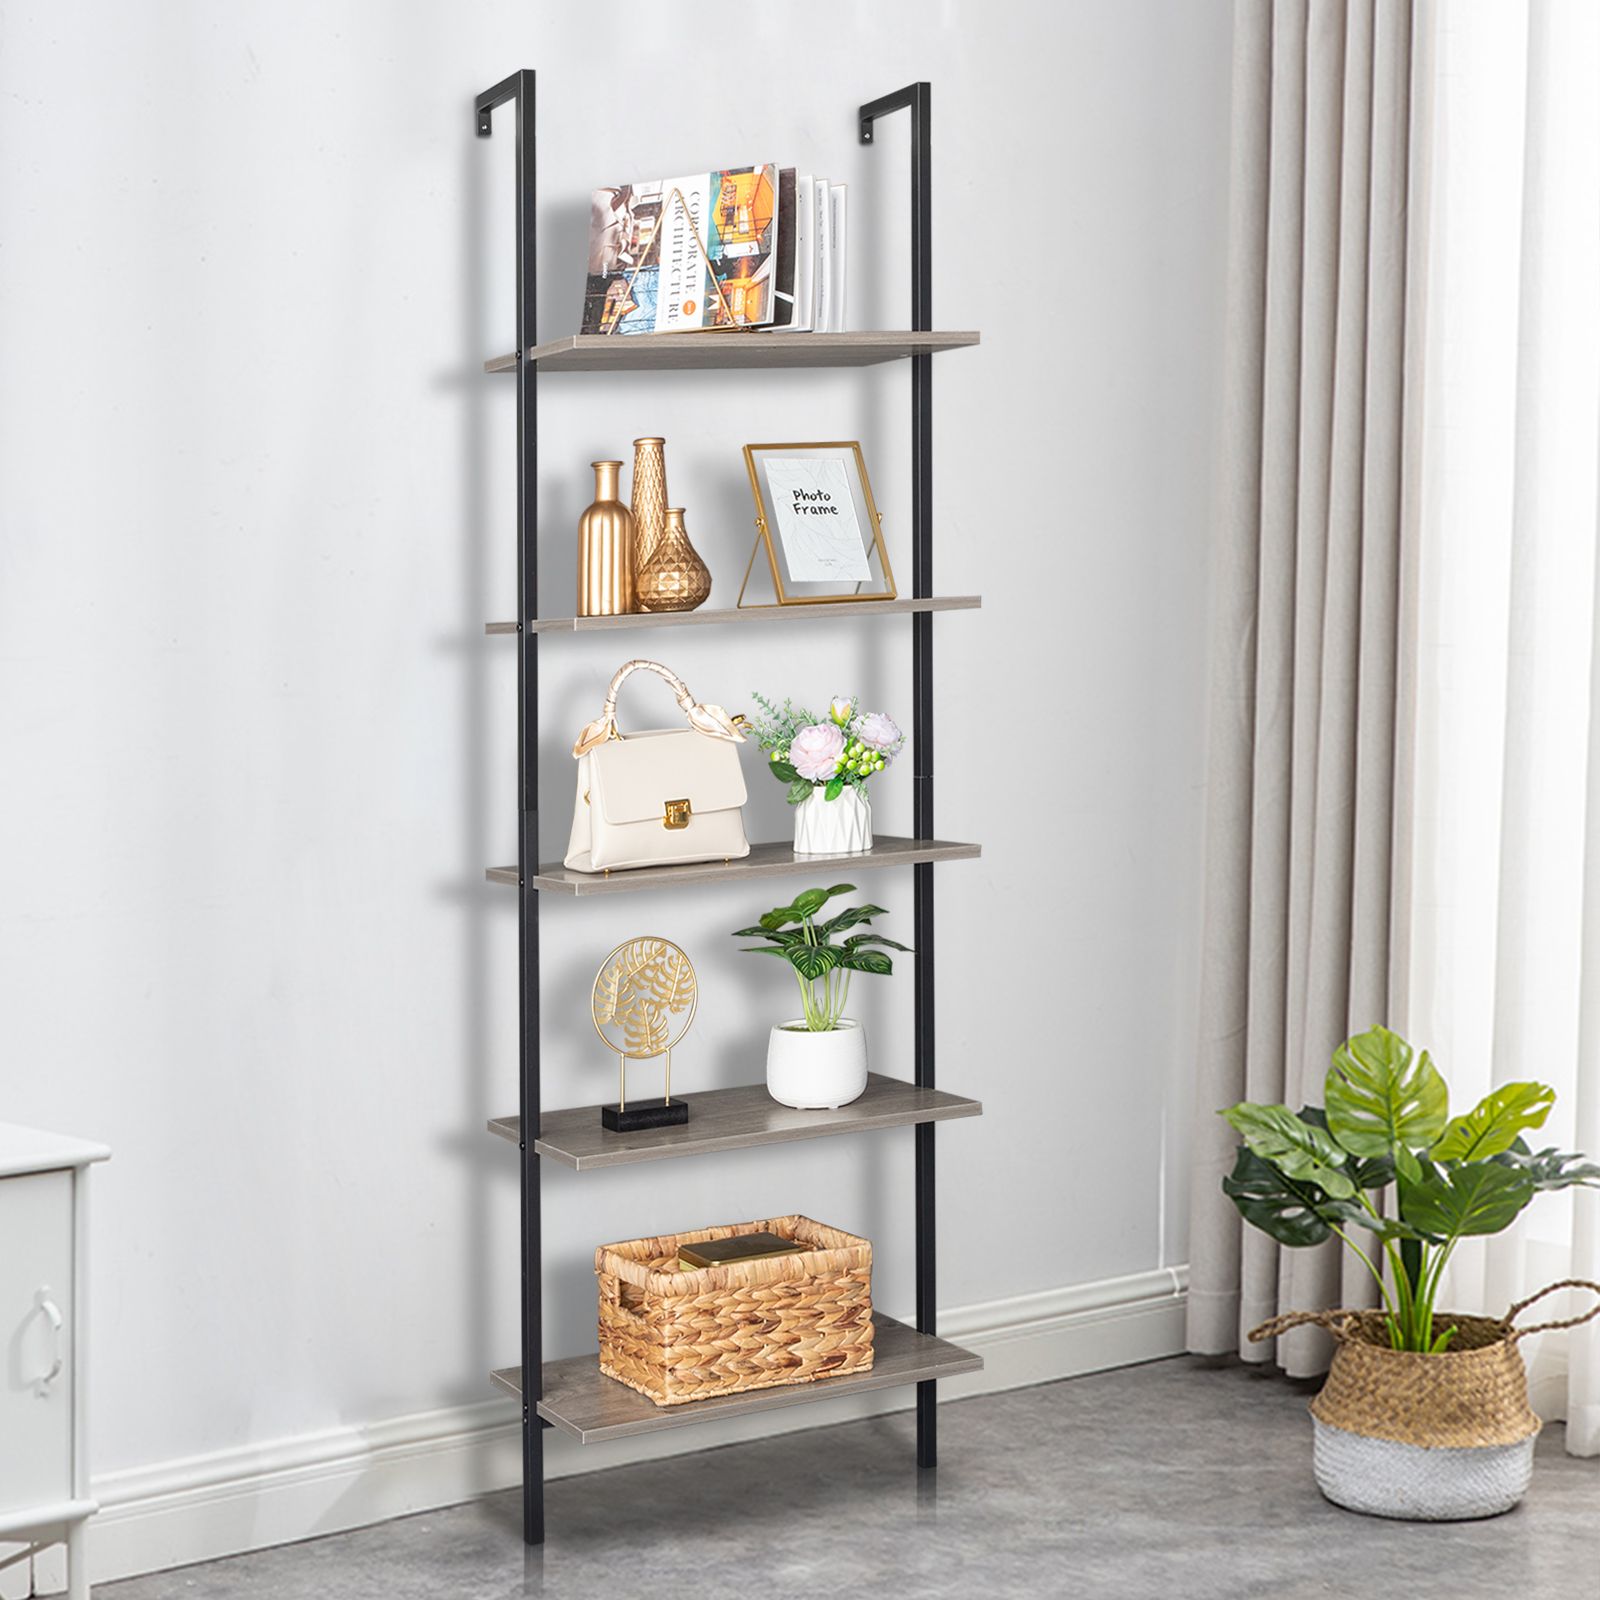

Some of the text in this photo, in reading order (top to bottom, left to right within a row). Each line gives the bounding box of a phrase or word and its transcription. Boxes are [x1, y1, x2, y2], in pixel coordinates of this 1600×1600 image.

[668, 193, 685, 323] ARCHITECTURE
[792, 488, 831, 502] Photo
[792, 502, 839, 515] Frame
